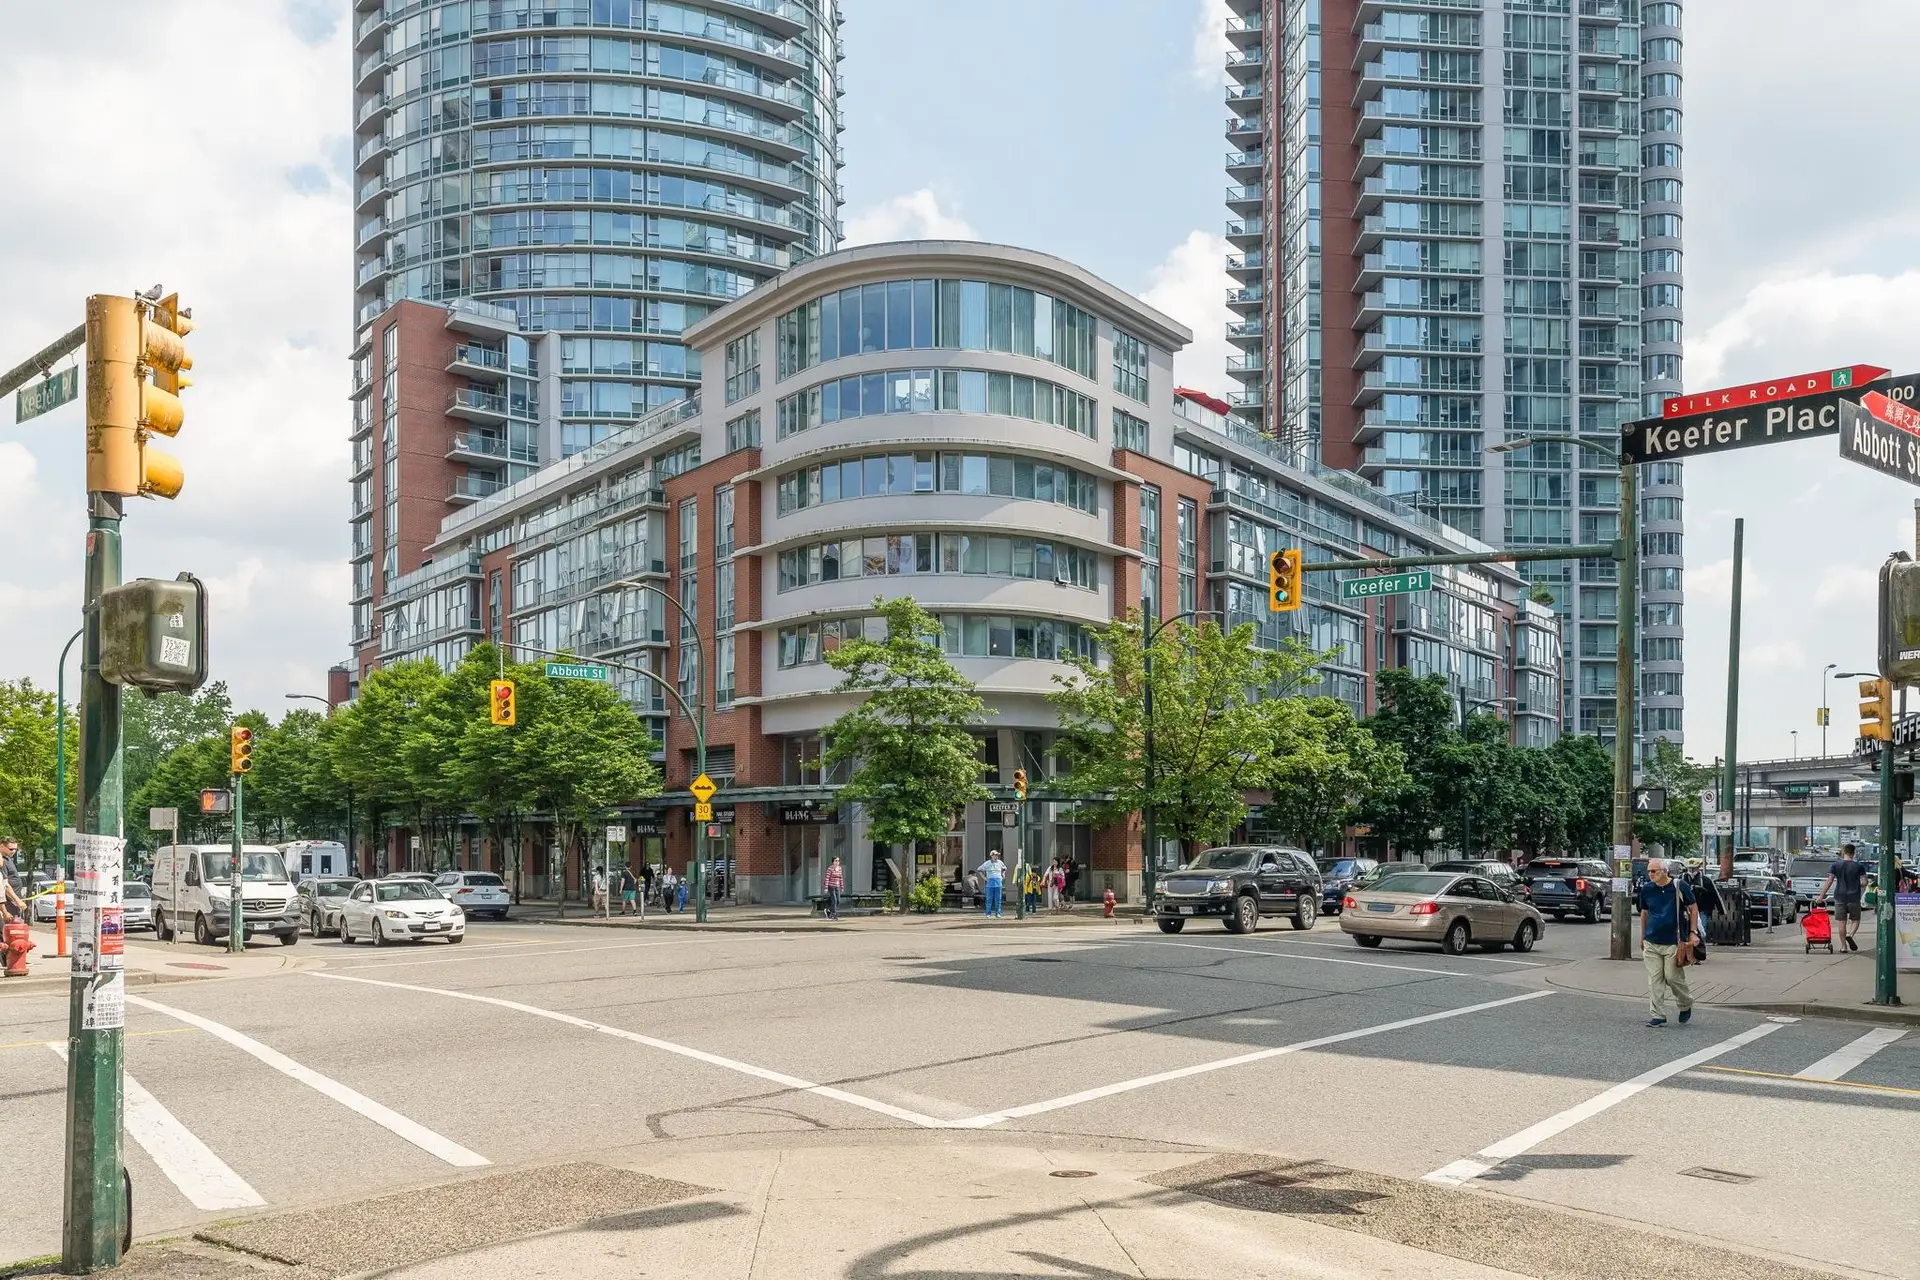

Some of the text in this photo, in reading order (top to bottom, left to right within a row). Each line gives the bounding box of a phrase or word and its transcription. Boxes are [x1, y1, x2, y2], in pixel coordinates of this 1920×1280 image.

[21, 385, 57, 416] Keefer
[1671, 379, 1817, 413] SILK ROAD
[1886, 385, 1915, 402] 100
[1645, 405, 1836, 455] Keefer Plac
[1853, 417, 1920, 477] Abbott St
[1350, 574, 1423, 595] Keefer Pl
[551, 666, 603, 678] Abbott St
[1854, 716, 1920, 757] BLEN OFFE
[698, 805, 708, 813] 30
